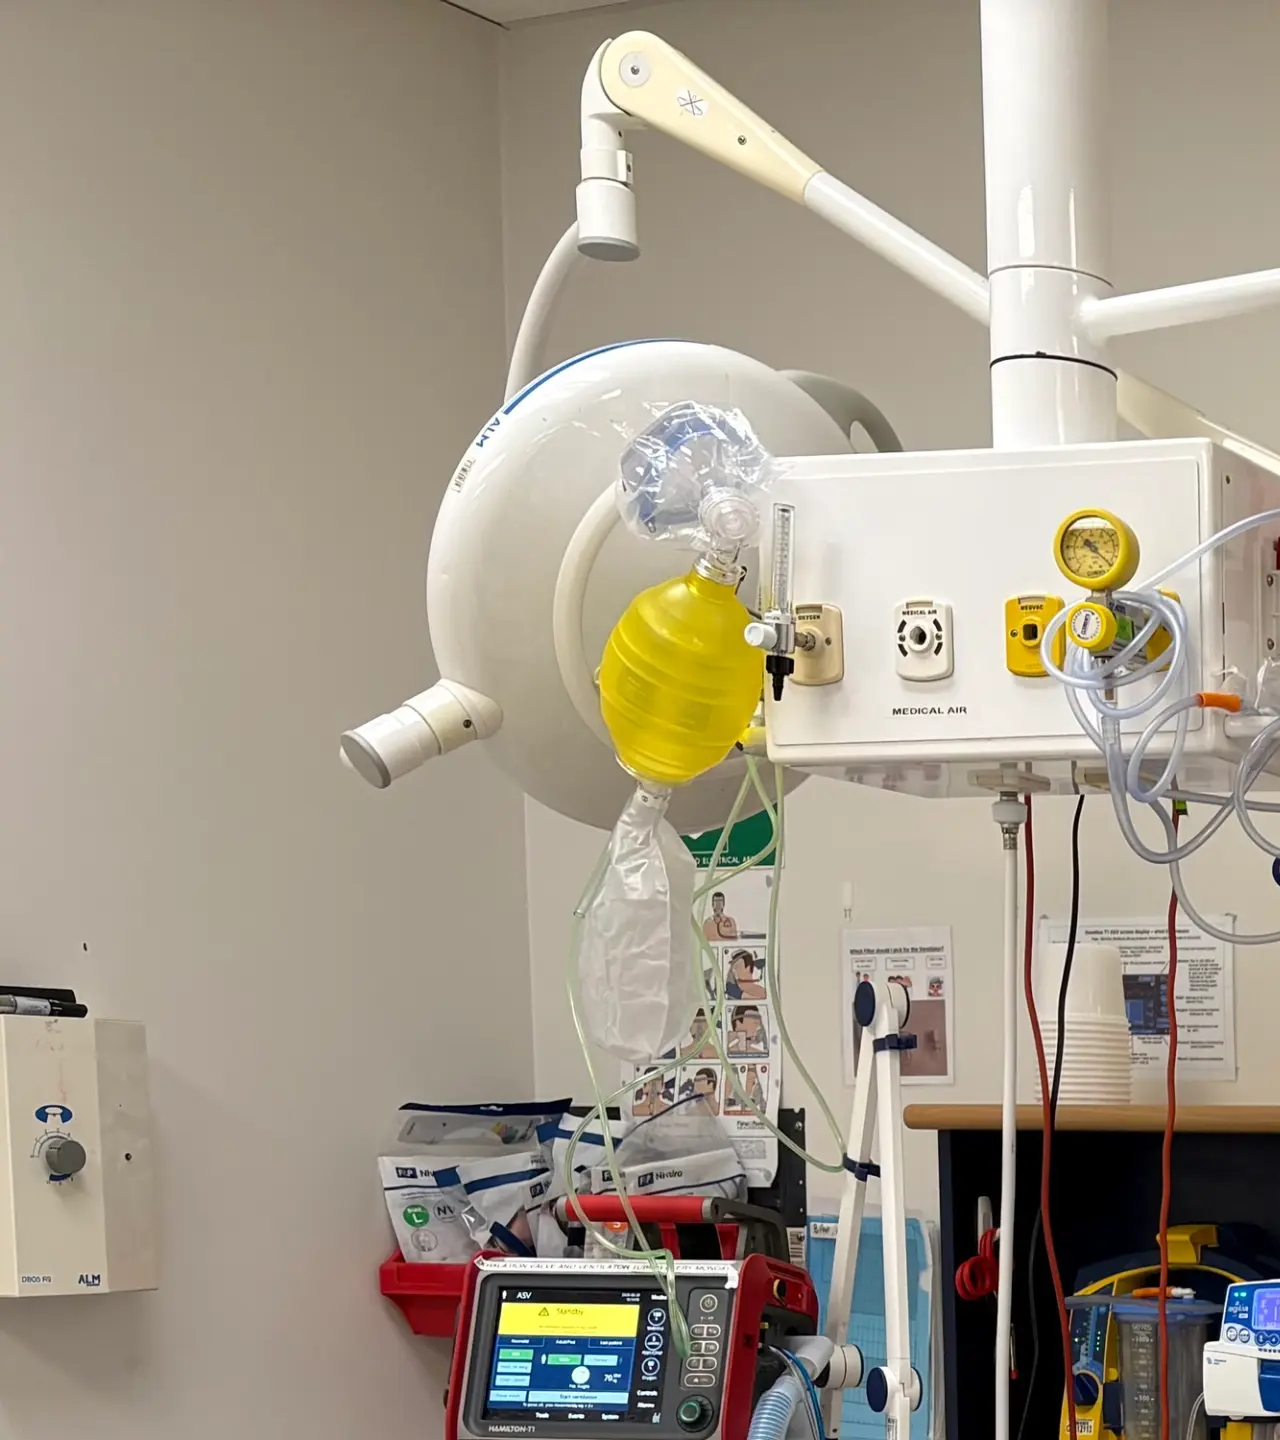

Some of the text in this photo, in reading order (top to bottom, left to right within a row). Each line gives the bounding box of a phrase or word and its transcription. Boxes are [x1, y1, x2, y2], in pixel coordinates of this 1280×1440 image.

[475, 416, 501, 448] ALM
[901, 608, 938, 617] MEDICAL AIR
[891, 705, 968, 716] MEDICAL AIR
[78, 1273, 101, 1286] ALM
[516, 1291, 532, 1300] ASV
[488, 1424, 536, 1433] HAMILTON-T1
